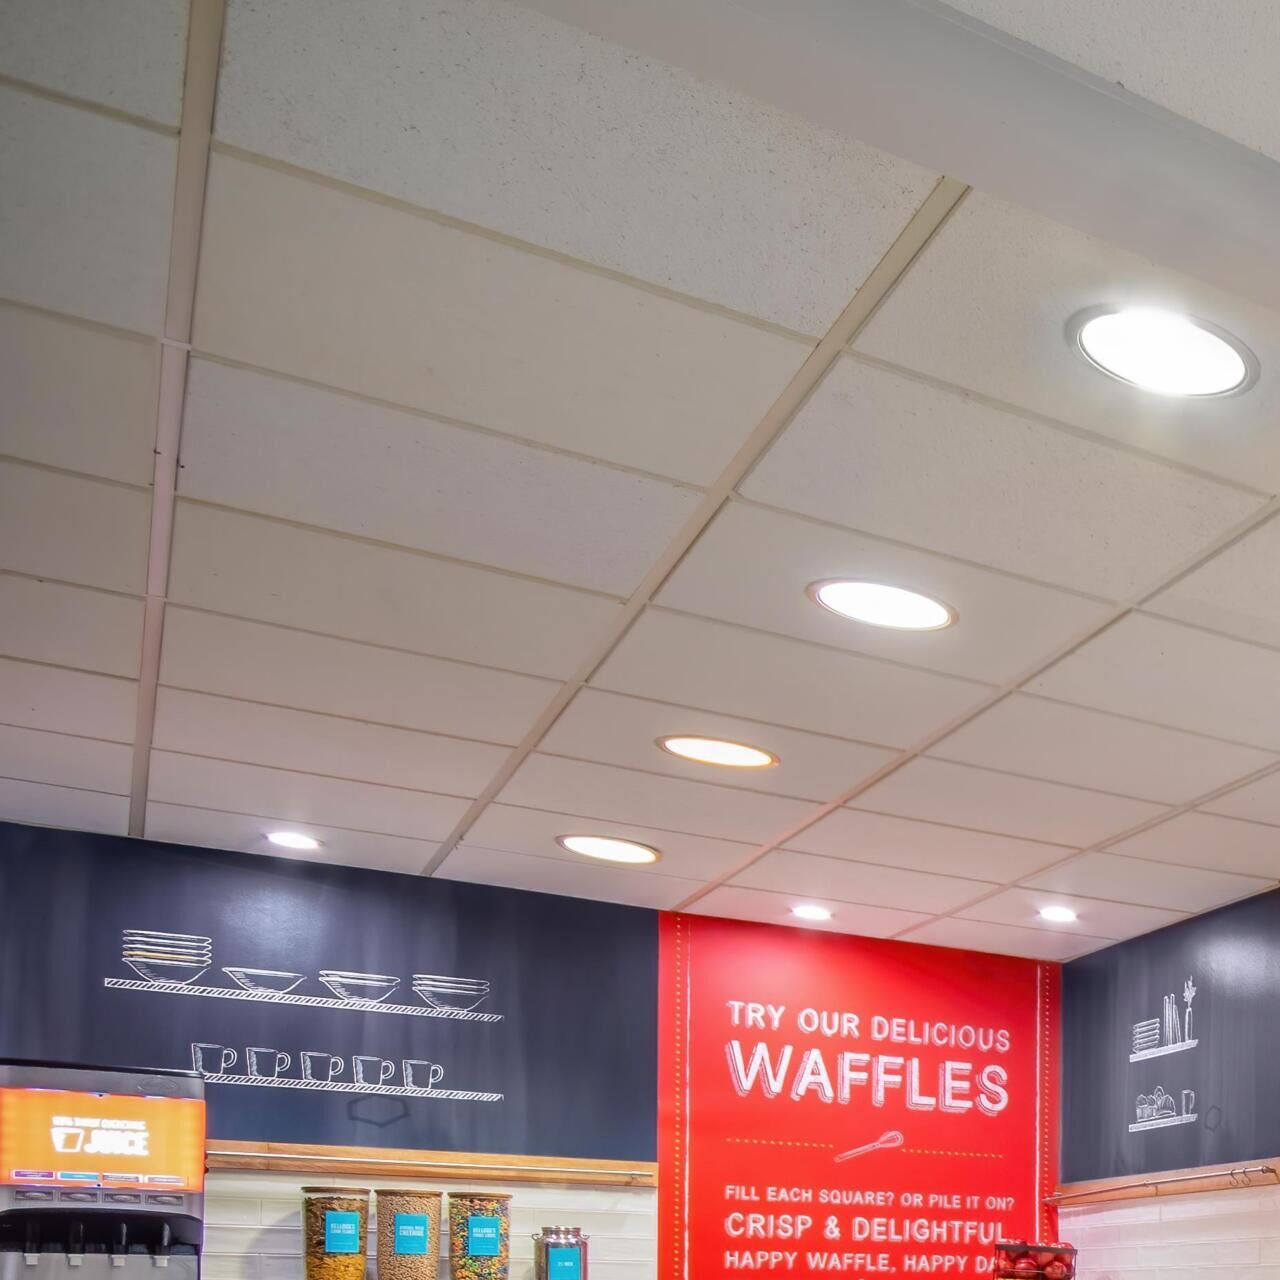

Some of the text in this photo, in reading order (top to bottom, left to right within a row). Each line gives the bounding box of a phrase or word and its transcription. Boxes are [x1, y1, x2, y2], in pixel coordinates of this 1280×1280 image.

[727, 1001, 1010, 1052] TRY OUR DELICIOUS
[725, 1040, 1009, 1116] WAFFLES
[725, 1185, 1015, 1211] FILL EACH SQUARE? OR PILE IT ON?
[724, 1212, 812, 1238] CRISP
[824, 1215, 840, 1240] &
[724, 1250, 797, 1269] HAPPY
[807, 1252, 896, 1273] WAFFLE,
[903, 1254, 968, 1273] HAPPY
